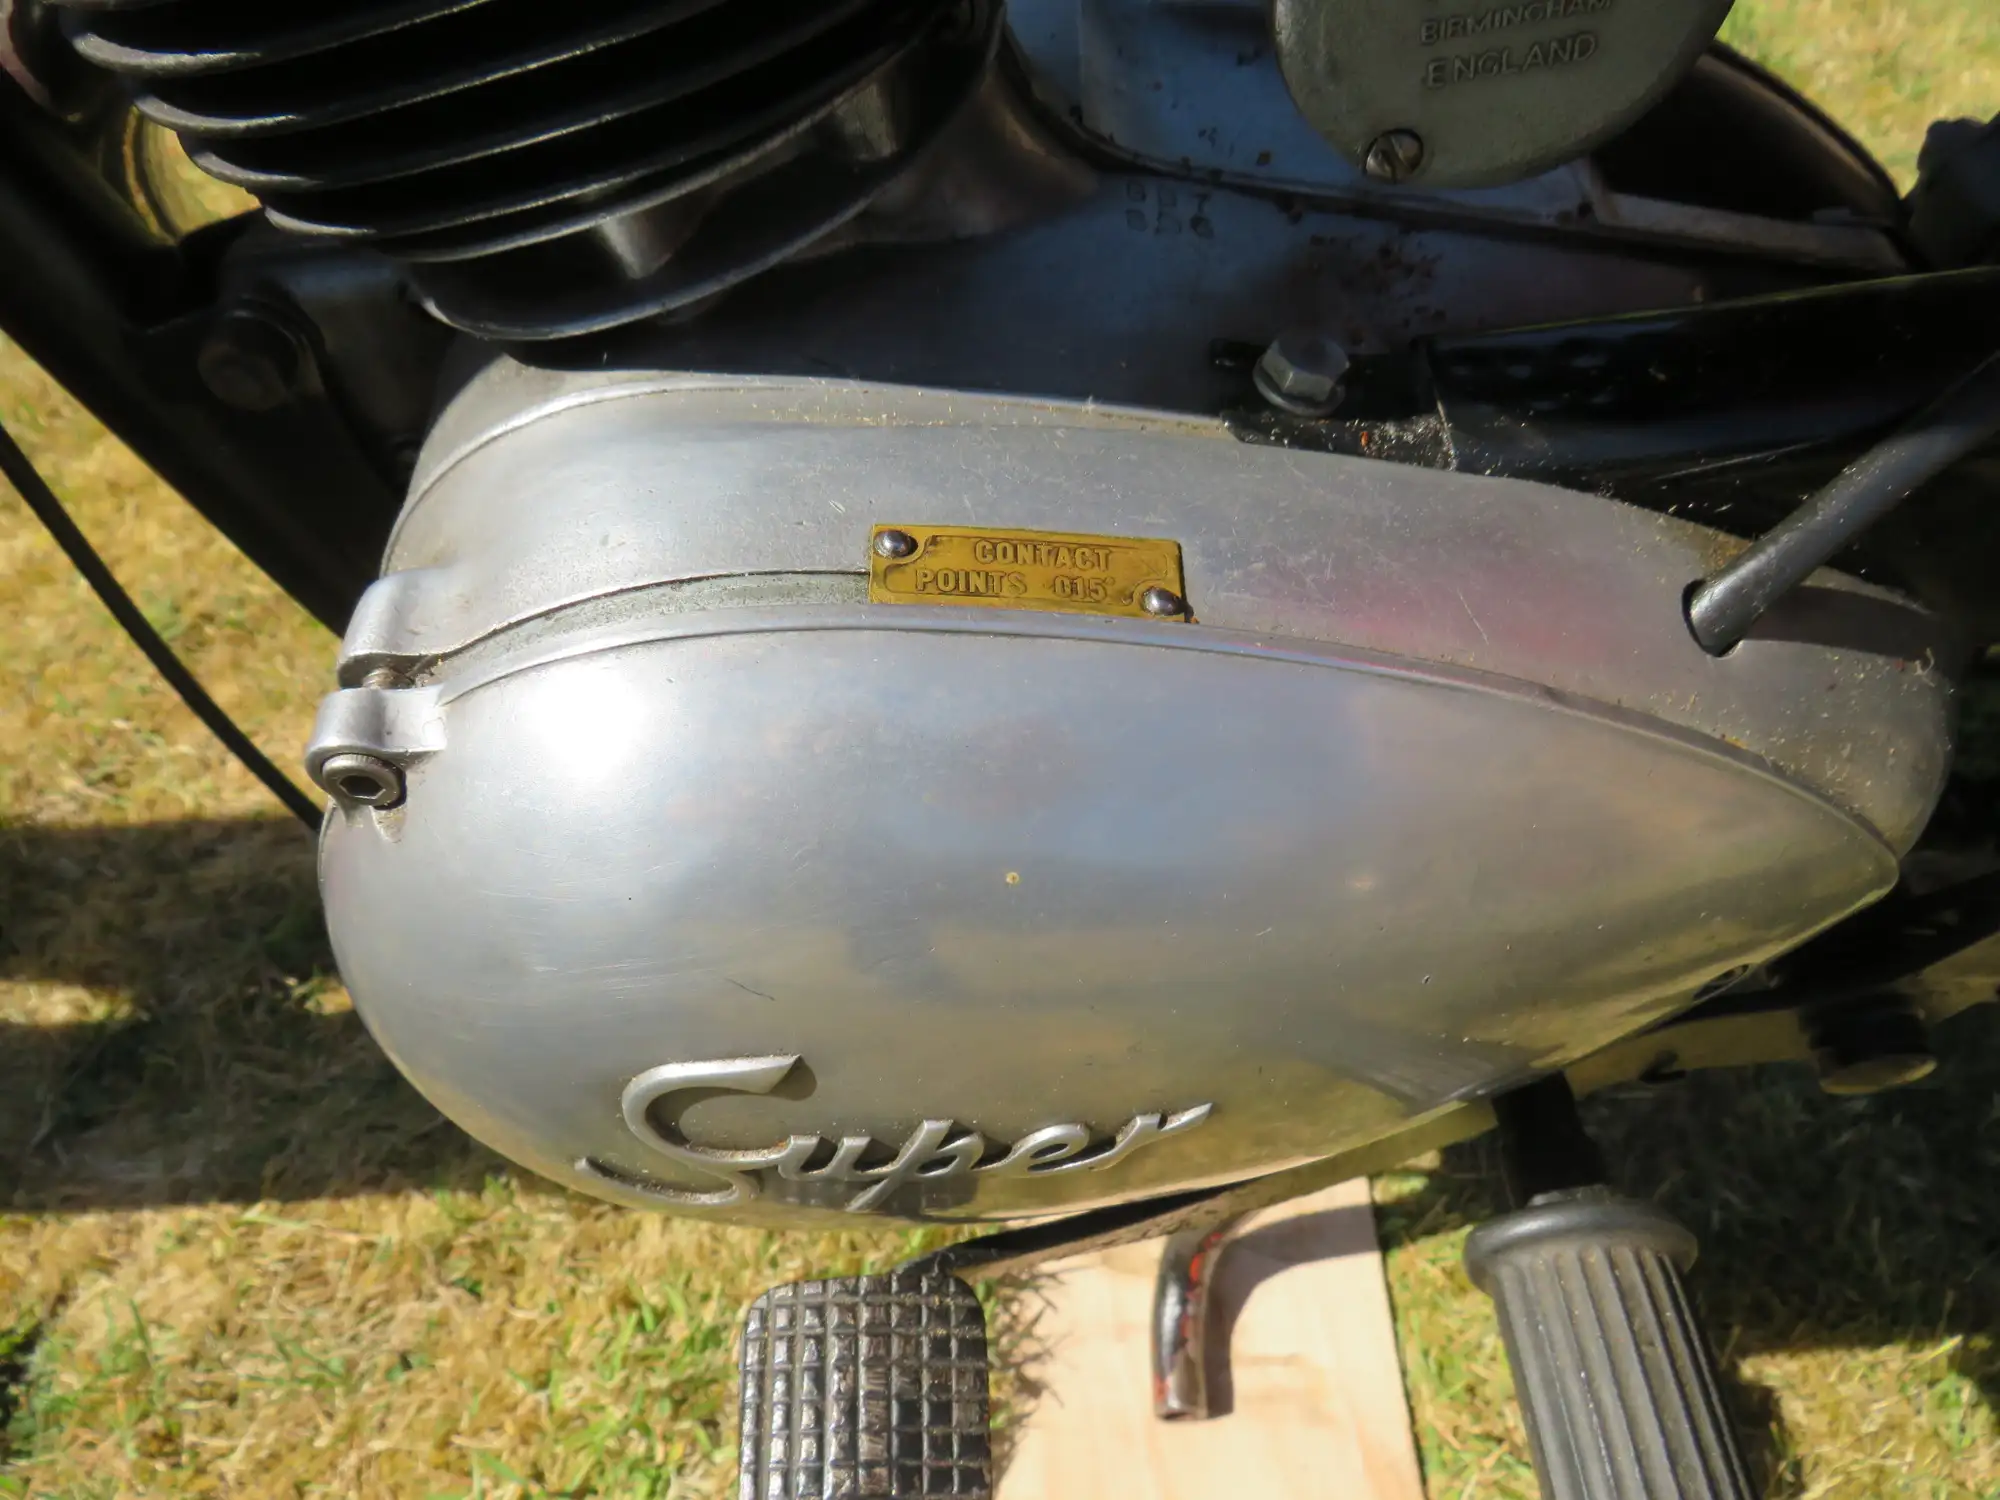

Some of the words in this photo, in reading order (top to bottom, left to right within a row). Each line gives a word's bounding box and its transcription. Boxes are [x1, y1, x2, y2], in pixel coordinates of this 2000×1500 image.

[1425, 32, 1598, 88] ENGLAND
[973, 539, 1113, 572] CONTACT
[915, 568, 1028, 597] POINTS
[573, 1053, 1213, 1212] Super
